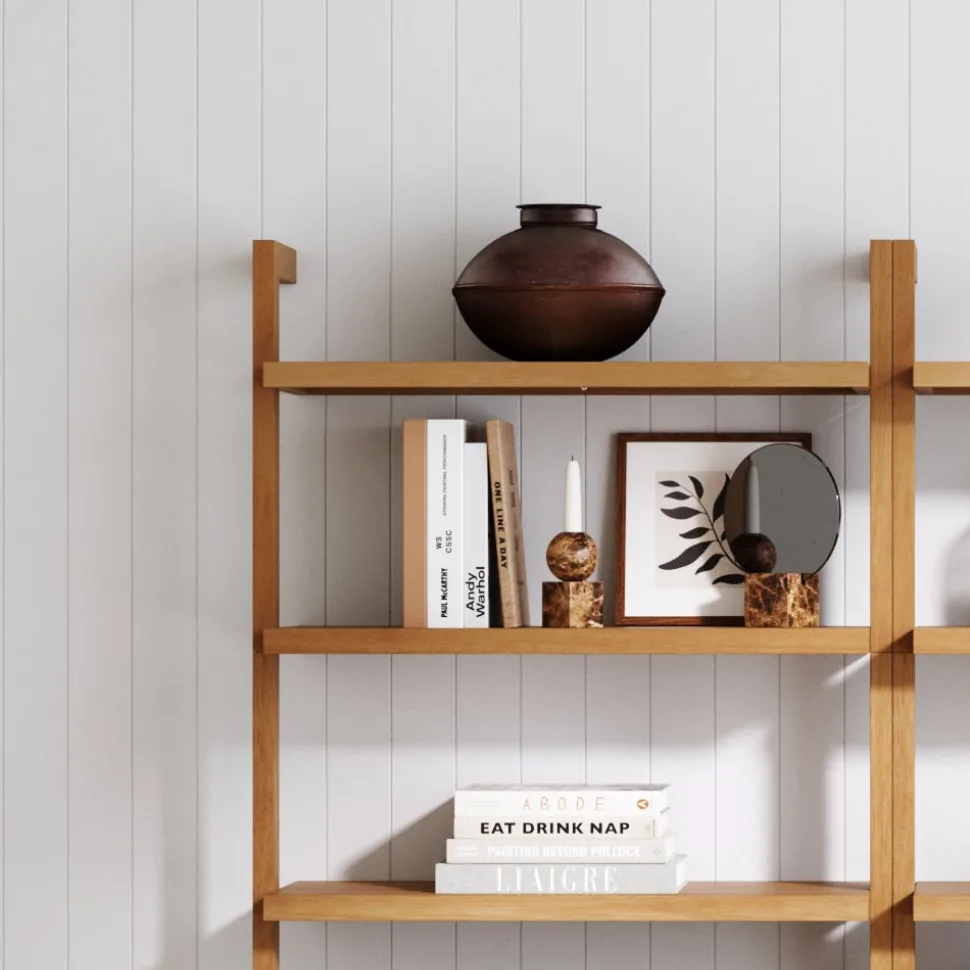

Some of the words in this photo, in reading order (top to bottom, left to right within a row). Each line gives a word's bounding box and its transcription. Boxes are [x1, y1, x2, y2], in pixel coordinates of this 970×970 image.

[494, 481, 503, 503] ONE
[496, 508, 506, 532] LINE
[435, 536, 443, 550] WS
[445, 530, 453, 554] CSSC
[500, 547, 509, 569] DAY
[465, 572, 478, 611] Andy
[475, 566, 486, 618] Warhol
[480, 822, 516, 834] EAT
[522, 822, 584, 834] DRINK
[590, 822, 630, 834] NAP
[495, 866, 618, 893] LIAIGRE
